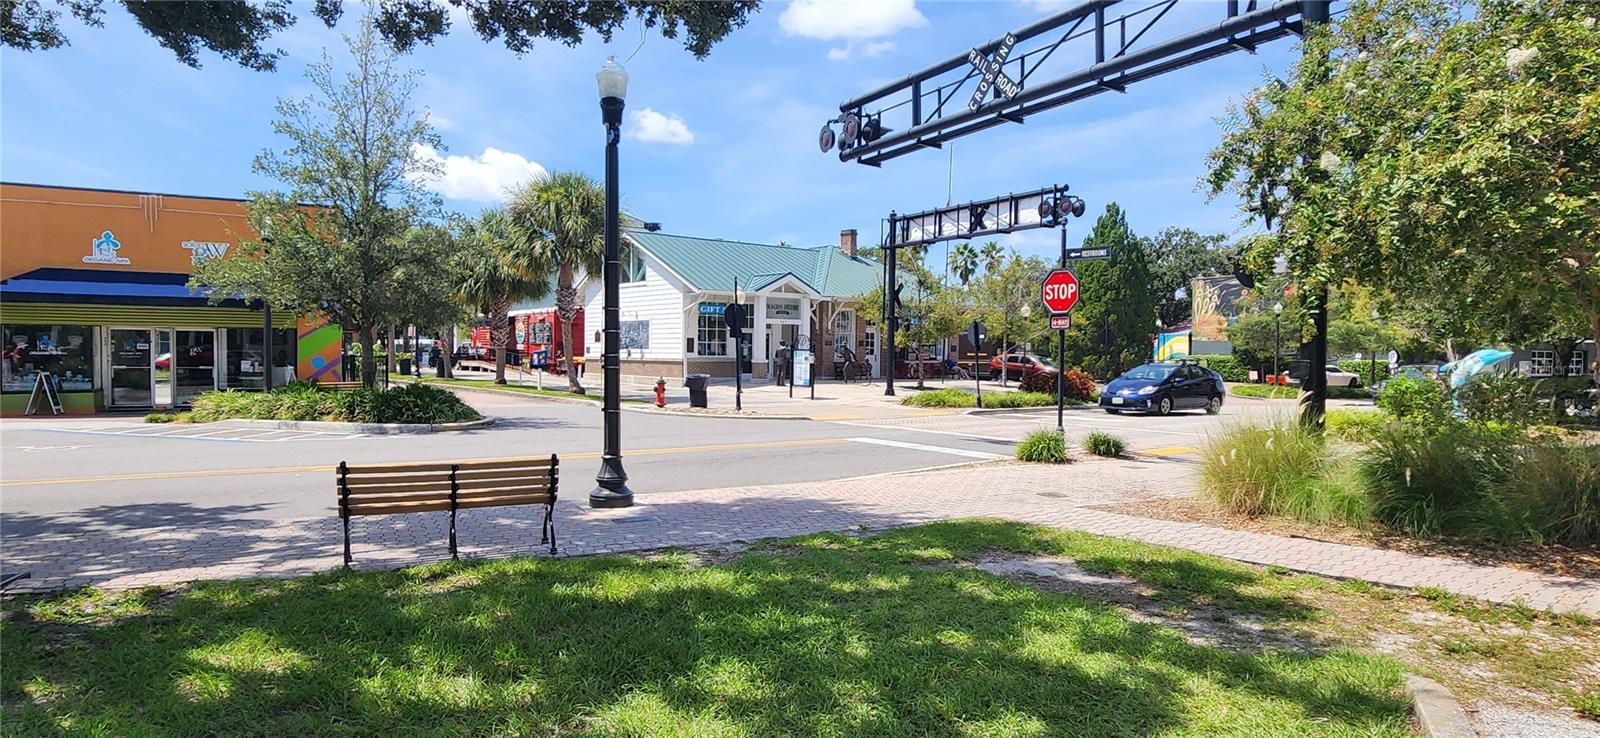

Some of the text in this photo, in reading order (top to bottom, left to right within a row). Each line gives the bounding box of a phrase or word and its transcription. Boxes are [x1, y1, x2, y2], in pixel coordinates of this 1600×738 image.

[968, 50, 1018, 98] RAIL ROAD
[969, 35, 1015, 111] CROSSING
[1082, 249, 1107, 257] RESTROOMS
[1046, 284, 1076, 300] STOP
[700, 305, 721, 313] GIFT
[1053, 318, 1068, 326] 4-WAY
